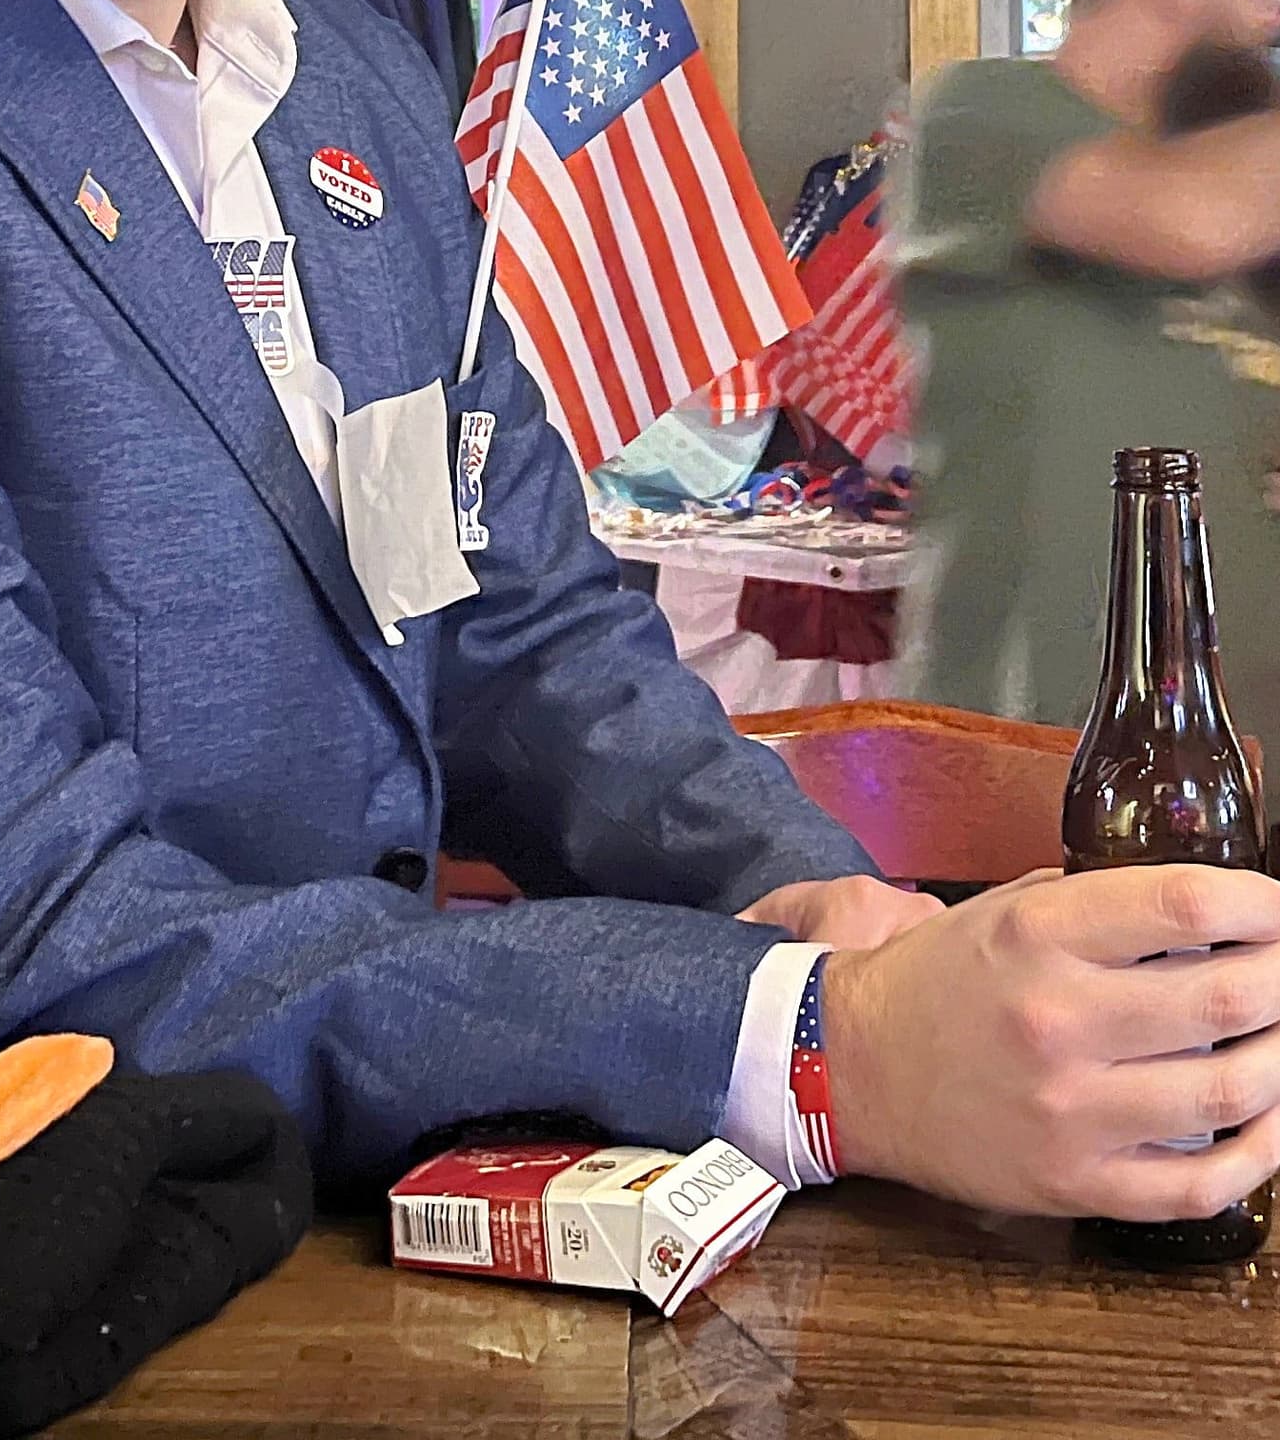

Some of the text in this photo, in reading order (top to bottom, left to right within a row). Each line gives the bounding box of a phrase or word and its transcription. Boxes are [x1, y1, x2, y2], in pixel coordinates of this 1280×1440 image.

[340, 159, 351, 174] I
[318, 168, 372, 204] VOTED
[326, 195, 368, 224] EARLY
[668, 1149, 754, 1217] BRONCO
[567, 1227, 583, 1251] 20
